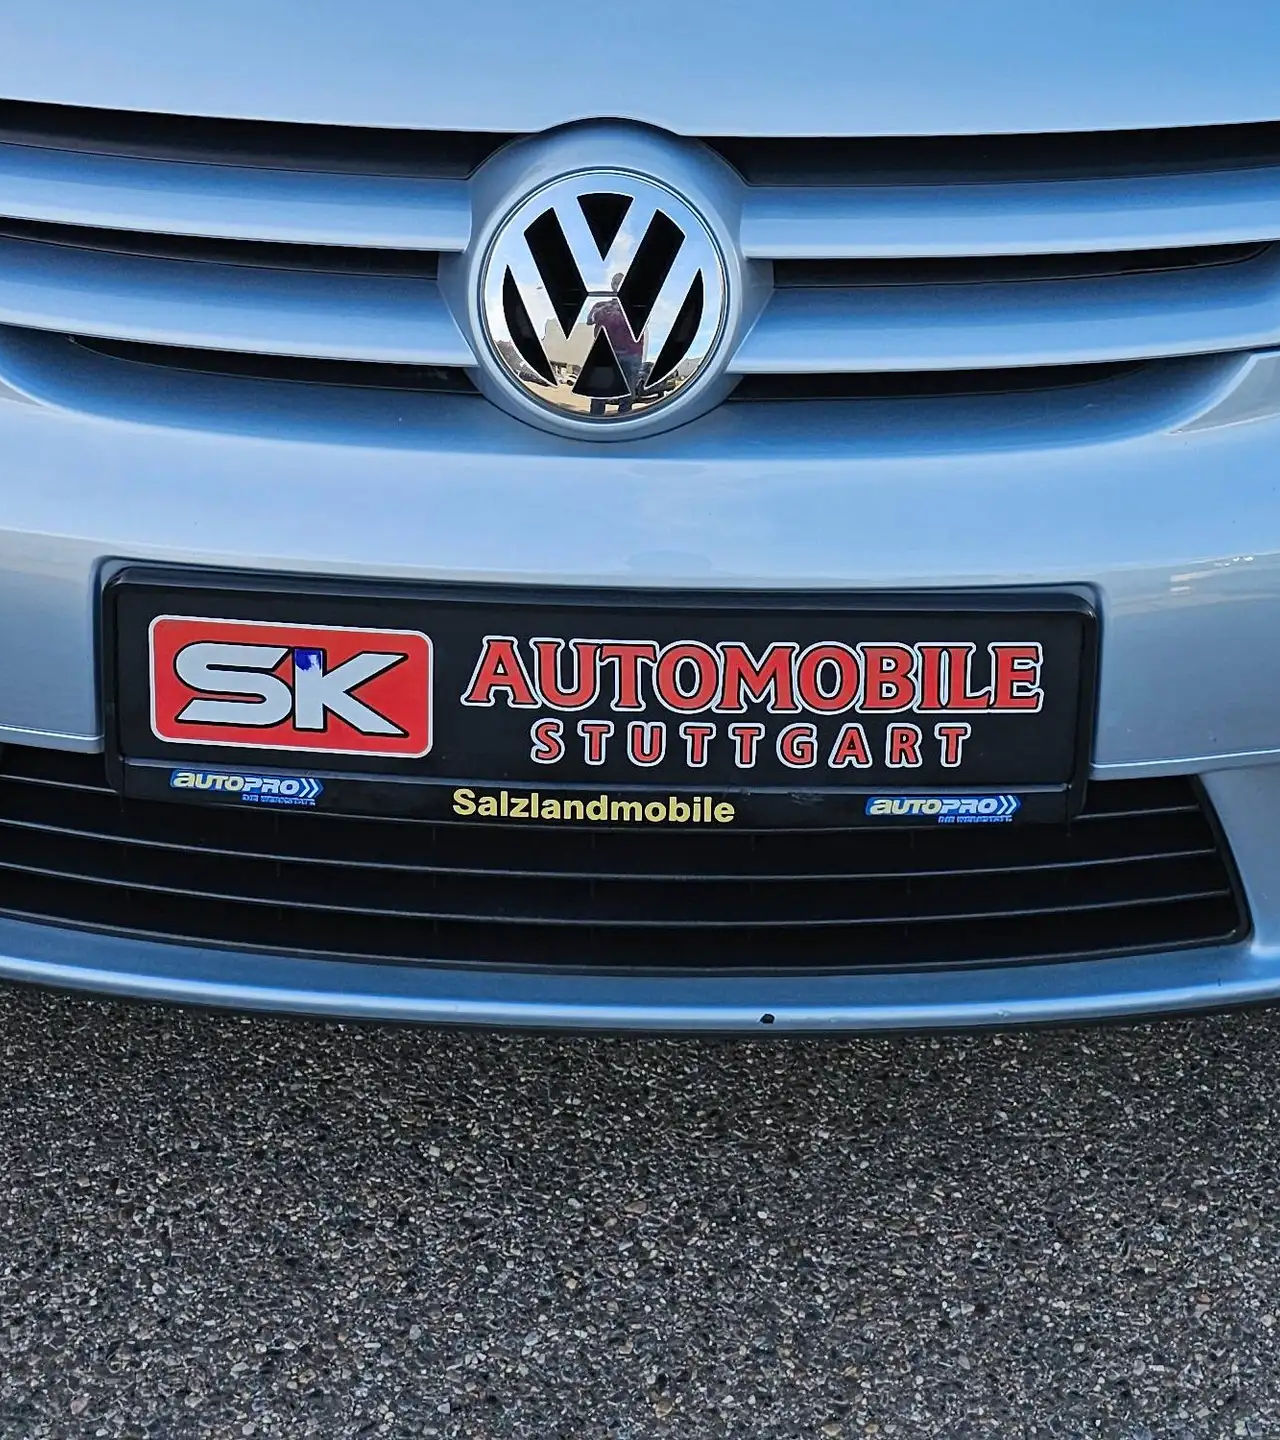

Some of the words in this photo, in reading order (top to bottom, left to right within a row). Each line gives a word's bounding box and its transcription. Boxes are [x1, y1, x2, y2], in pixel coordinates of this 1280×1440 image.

[174, 640, 410, 738] SK
[461, 636, 1043, 715] AUTOMOBILE
[531, 719, 971, 769] STUTTGART
[452, 788, 736, 823] Salzlandmobile
